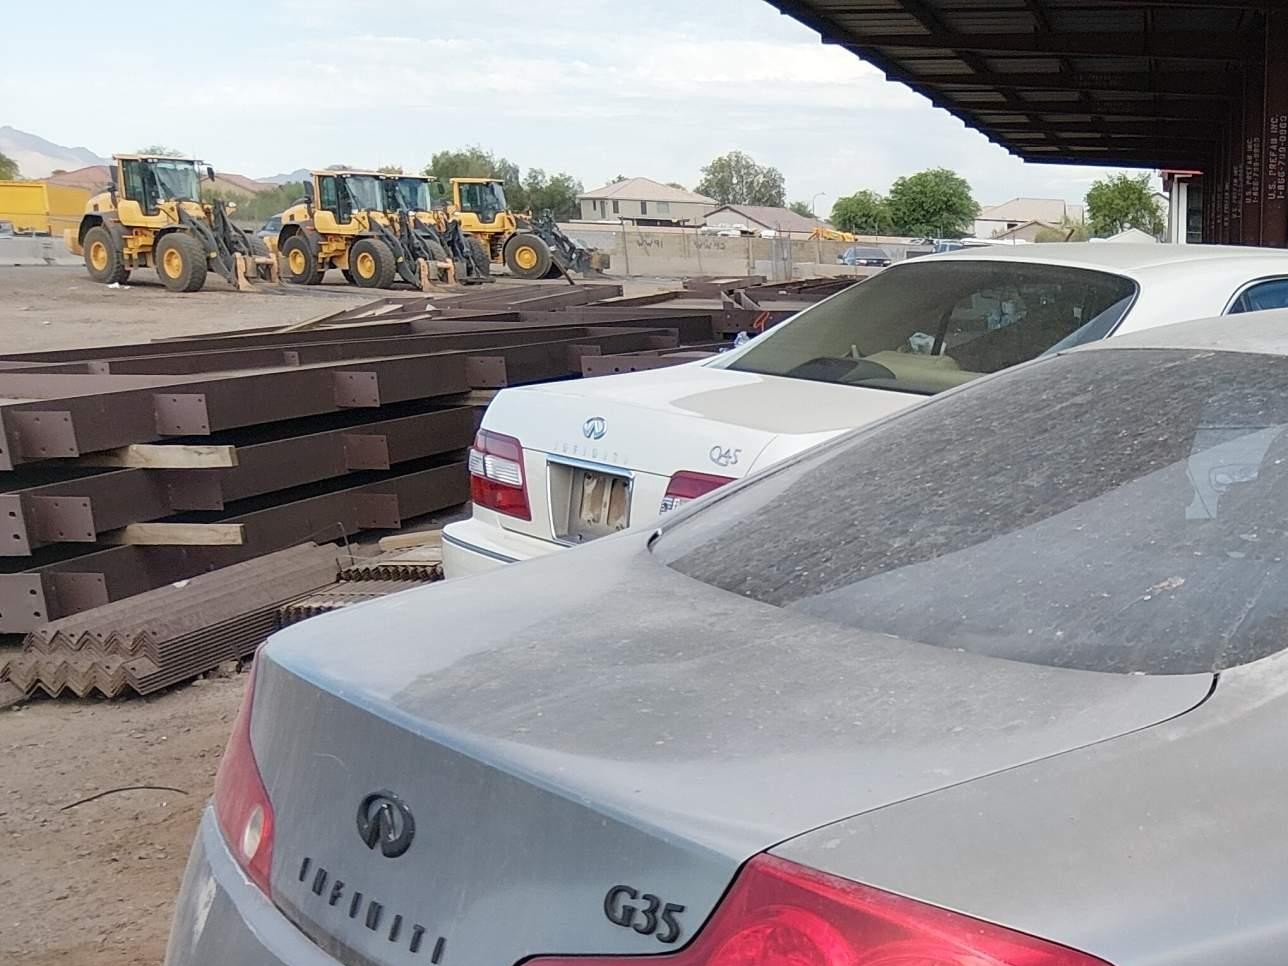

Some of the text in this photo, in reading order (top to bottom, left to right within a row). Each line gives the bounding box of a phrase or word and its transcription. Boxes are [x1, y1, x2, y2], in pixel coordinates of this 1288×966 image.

[709, 445, 742, 467] Q45
[298, 857, 448, 965] INFINITI
[603, 884, 686, 944] G35
